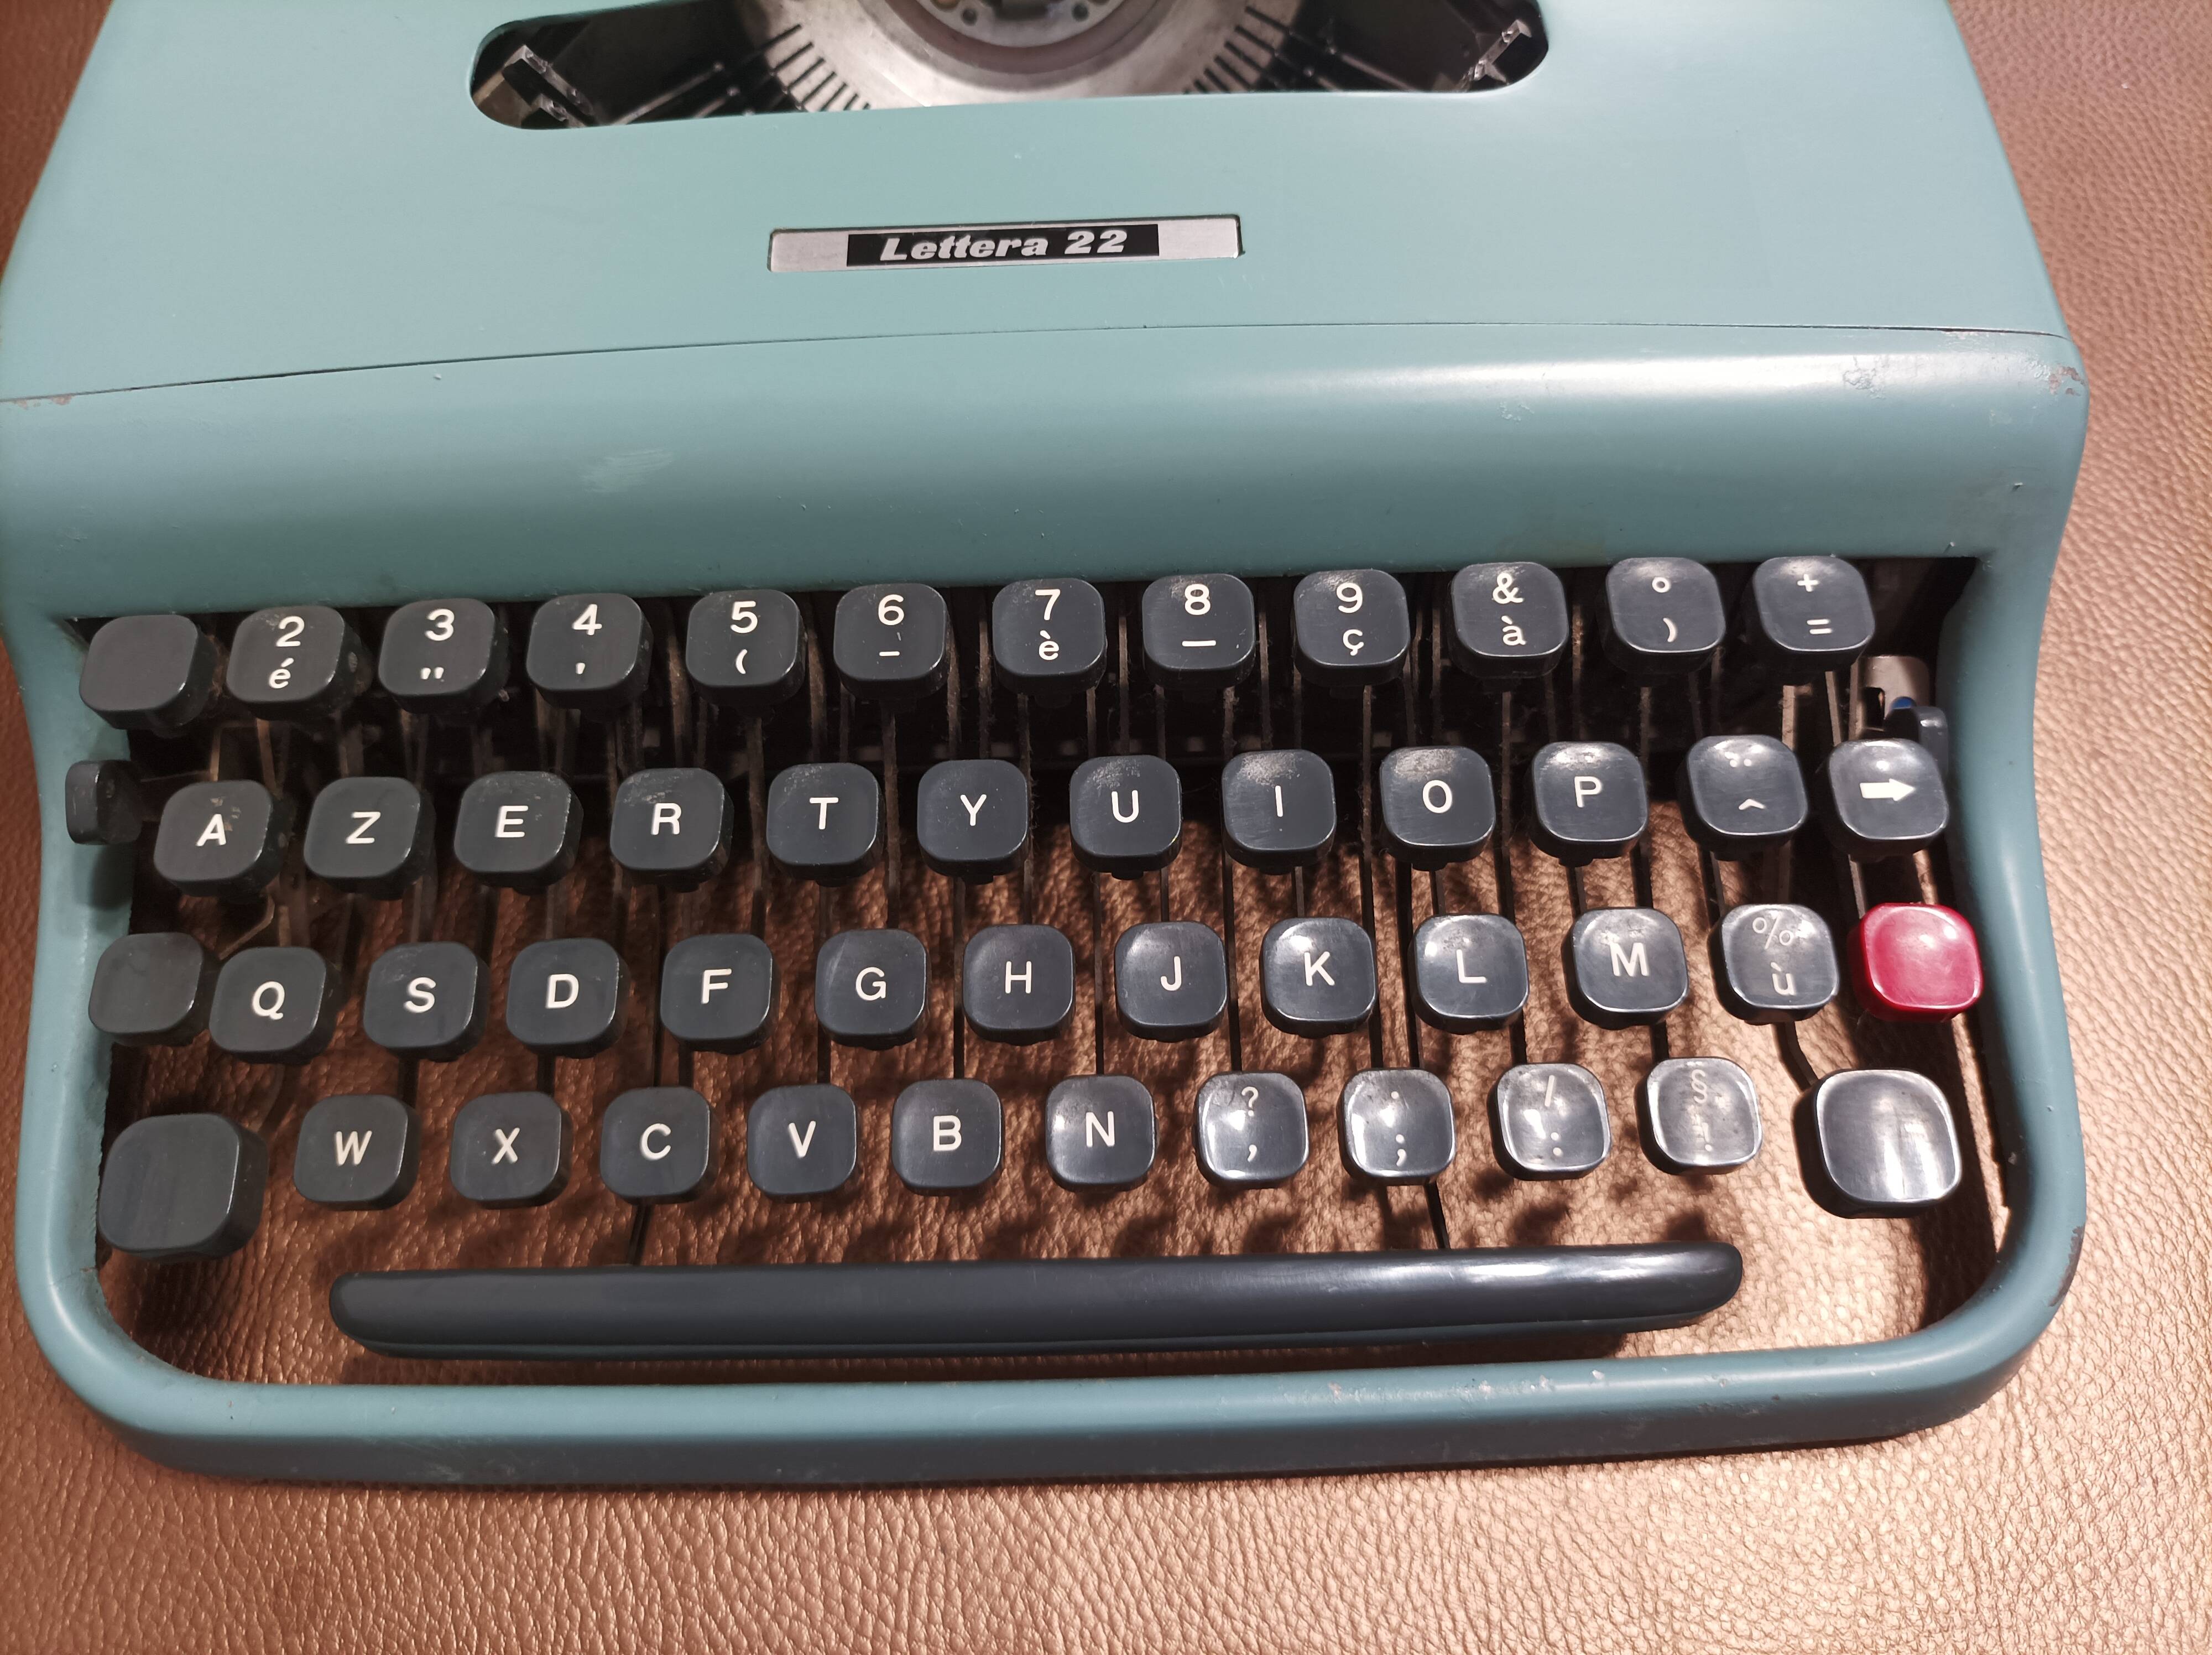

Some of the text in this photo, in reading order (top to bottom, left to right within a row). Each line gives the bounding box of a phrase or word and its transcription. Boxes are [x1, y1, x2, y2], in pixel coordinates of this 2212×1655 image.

[880, 230, 1127, 261] Lettera 22
[1185, 584, 1211, 615] 8
[1337, 582, 1364, 612] 9
[1492, 573, 1524, 603] &
[573, 604, 602, 635] 4
[731, 601, 758, 633] 5
[878, 595, 904, 624] 6
[1035, 589, 1060, 620] 7
[276, 616, 304, 647] 2
[425, 609, 453, 641] 3
[1503, 617, 1526, 645] à
[1663, 618, 1677, 642] )
[1038, 632, 1059, 660] è
[1343, 629, 1364, 655] ç
[268, 658, 293, 689] é
[735, 649, 747, 674] (
[1112, 790, 1139, 823] U
[1422, 779, 1453, 814] O
[1574, 776, 1602, 808] P
[495, 806, 528, 838] E
[651, 803, 681, 835] R
[809, 797, 839, 830] T
[960, 794, 987, 826] Y
[197, 814, 226, 846] A
[346, 811, 381, 844] Z
[1751, 917, 1794, 949] %
[1160, 956, 1182, 991] J
[1305, 951, 1335, 986] K
[1456, 950, 1488, 984] L
[1609, 942, 1649, 976] M
[545, 974, 579, 1008] D
[701, 969, 732, 1005] F
[855, 967, 886, 1000] G
[1004, 961, 1032, 994] H
[1771, 962, 1795, 996] ù
[251, 981, 285, 1019] Q
[403, 977, 436, 1013] S
[1241, 1086, 1259, 1116] ?
[1691, 1069, 1708, 1104] §
[640, 1123, 672, 1160] C
[788, 1121, 816, 1158] V
[933, 1115, 962, 1152] B
[1086, 1111, 1116, 1146] N
[1551, 1132, 1563, 1157] :
[1702, 1122, 1712, 1152] !
[334, 1130, 372, 1165] W
[491, 1127, 520, 1164] X
[1395, 1134, 1407, 1167] ;
